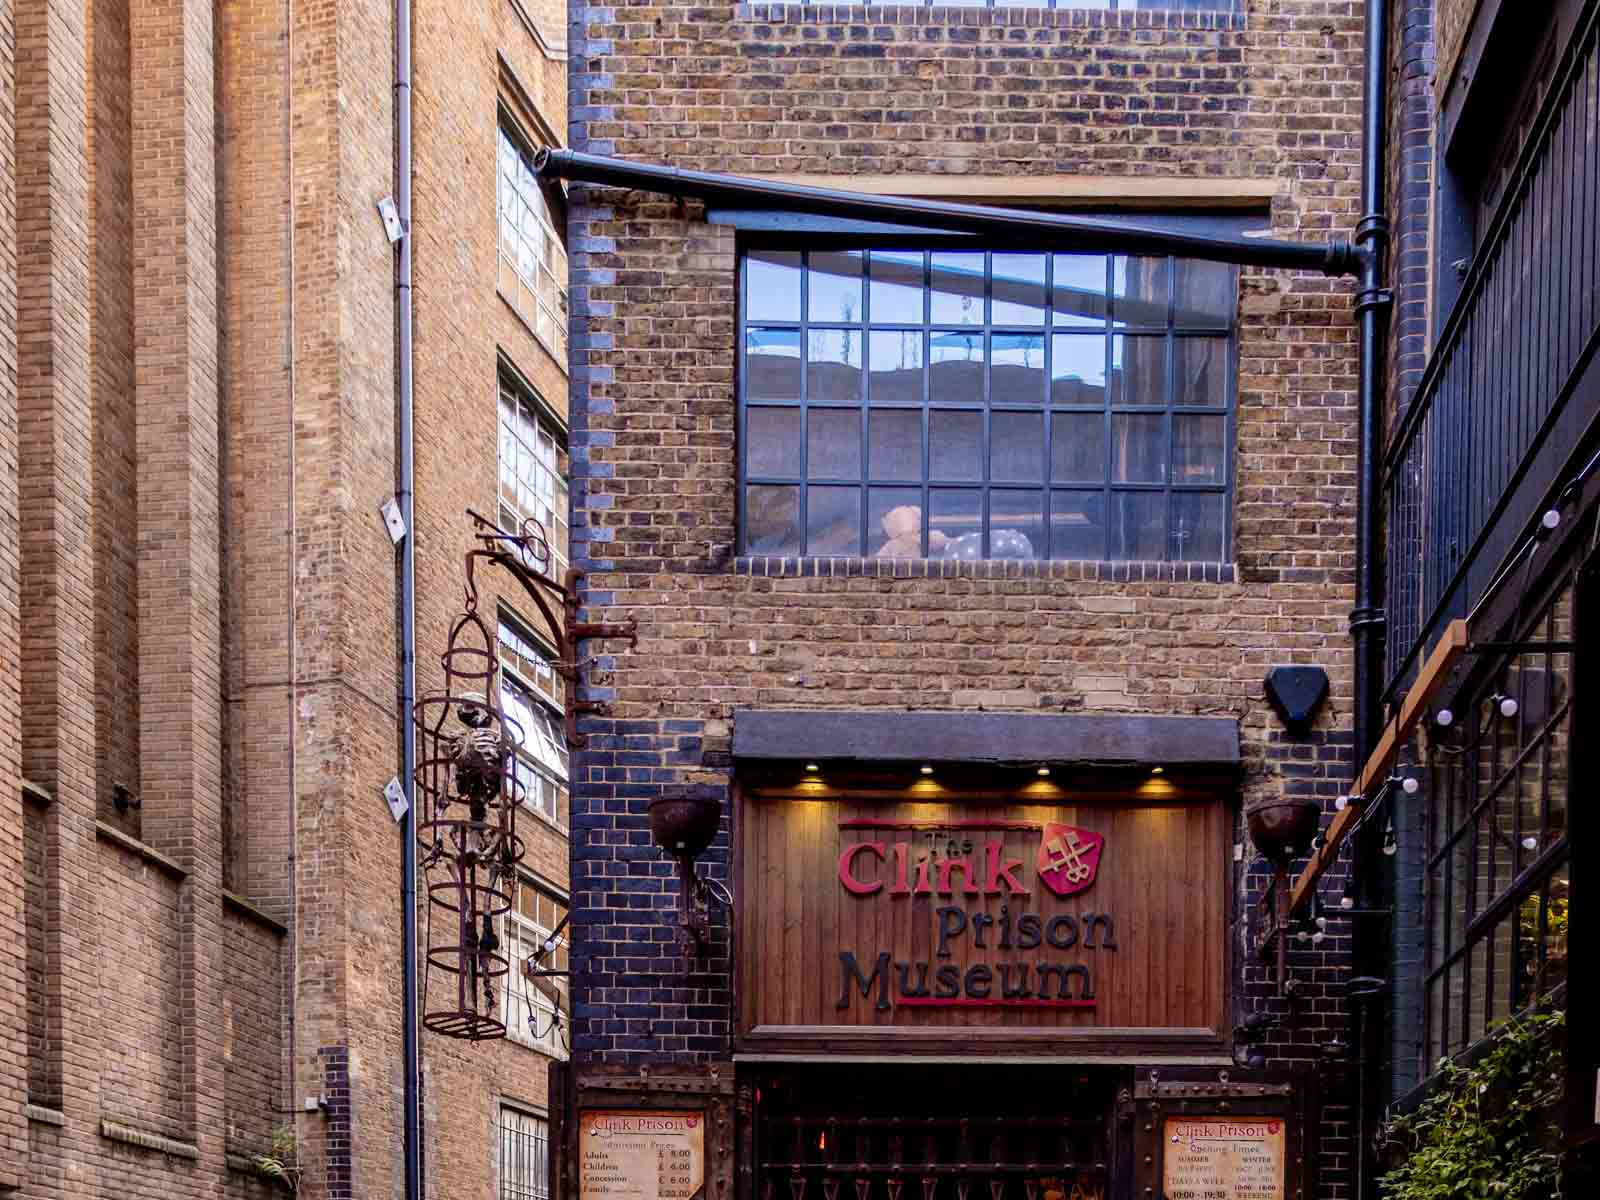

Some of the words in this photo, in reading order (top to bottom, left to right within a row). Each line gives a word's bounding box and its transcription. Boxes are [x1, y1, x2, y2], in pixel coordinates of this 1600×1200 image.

[924, 832, 973, 857] The
[838, 841, 1031, 898] Clink
[936, 905, 1117, 957] Prison
[836, 951, 1095, 1010] Museum
[594, 1119, 632, 1130] Clink
[638, 1118, 684, 1131] Prison
[1176, 1124, 1213, 1136] Clink
[1219, 1124, 1264, 1137] Prison
[584, 1175, 627, 1183] Concession
[1173, 1191, 1194, 1200] 10:00
[1203, 1191, 1225, 1200] 19:30
